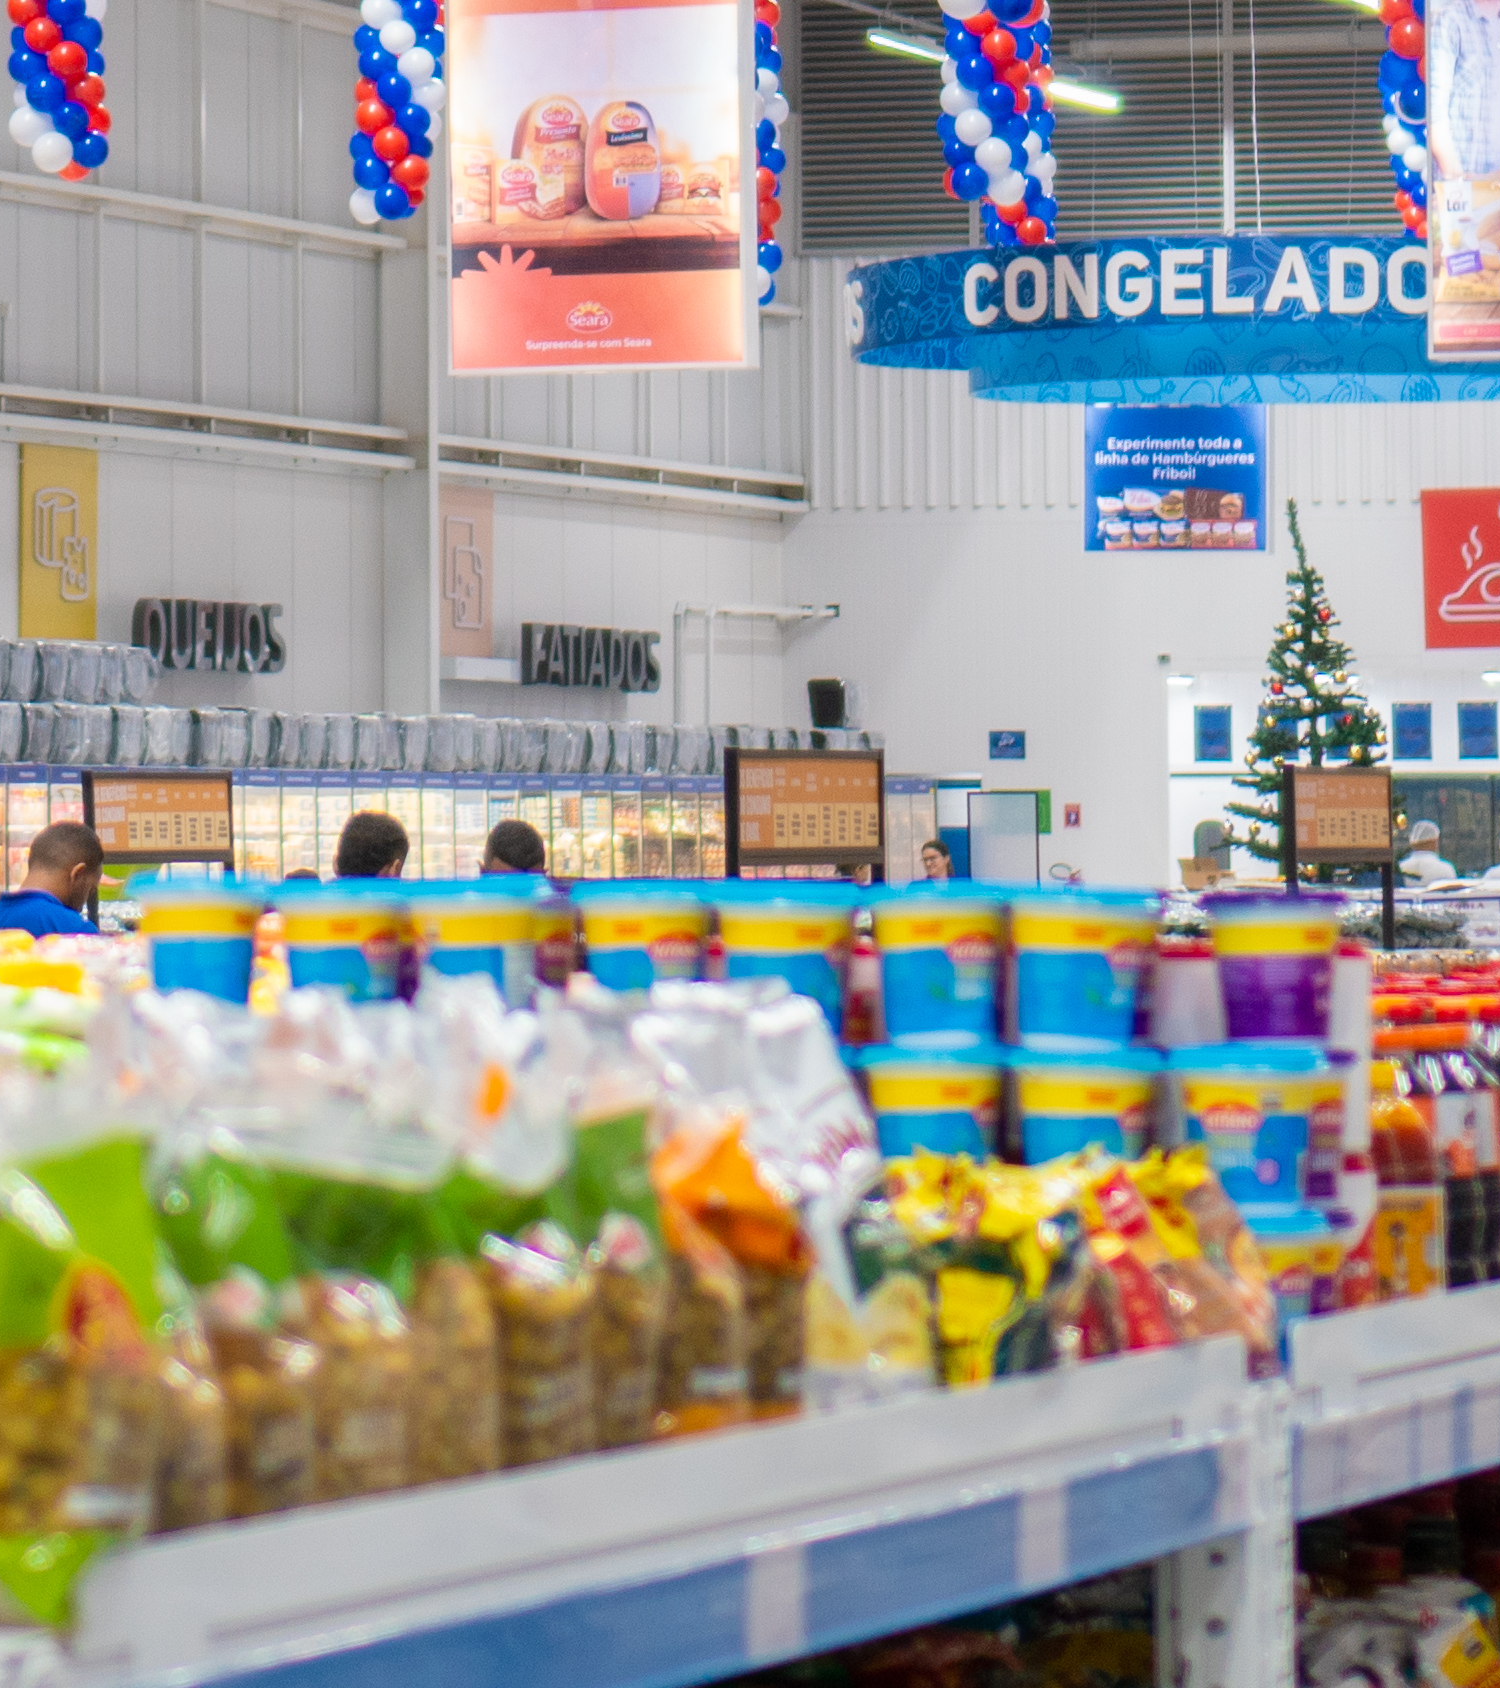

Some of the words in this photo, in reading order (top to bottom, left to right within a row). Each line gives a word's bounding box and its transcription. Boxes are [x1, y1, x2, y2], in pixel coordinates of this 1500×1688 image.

[963, 245, 1430, 328] CONGELADO
[569, 313, 609, 327] Seara
[1095, 452, 1128, 465] linha
[1131, 452, 1149, 465] de
[1152, 451, 1255, 467] Hambúrgueres
[1107, 436, 1195, 451] Experimente
[1198, 436, 1230, 449] toda
[132, 598, 286, 673] QUEIJOS
[521, 622, 662, 694] FATIADOS
